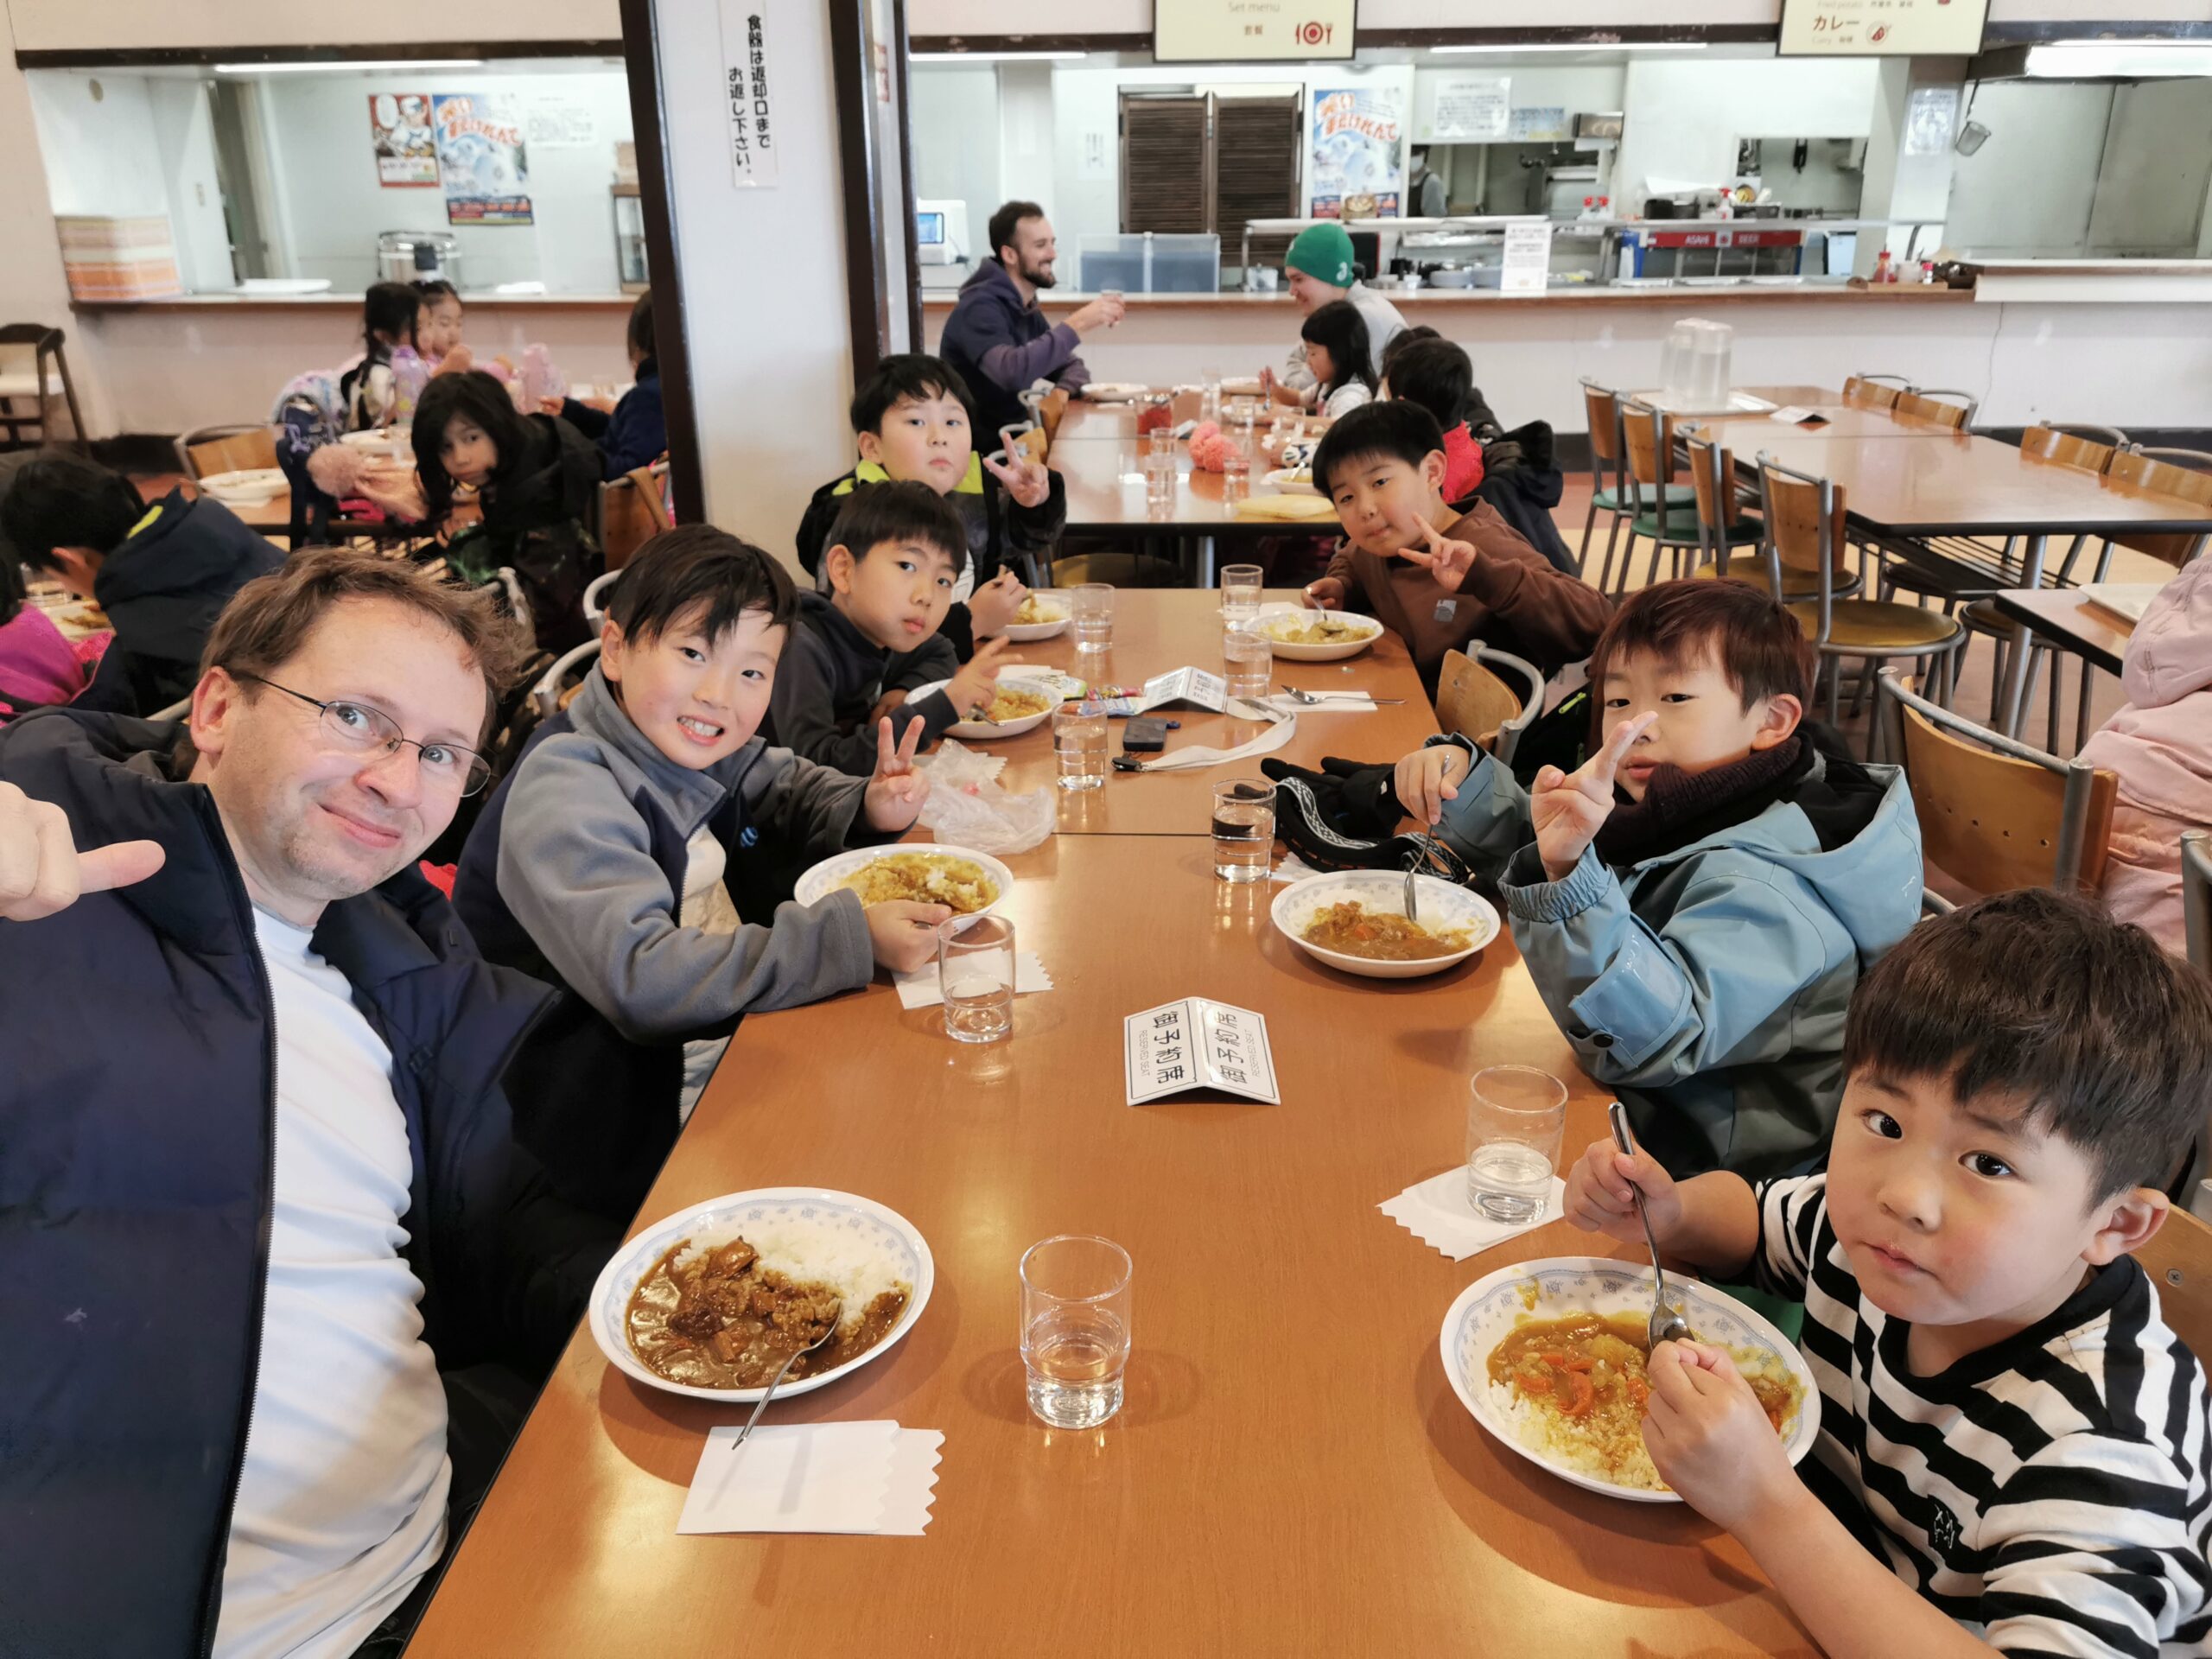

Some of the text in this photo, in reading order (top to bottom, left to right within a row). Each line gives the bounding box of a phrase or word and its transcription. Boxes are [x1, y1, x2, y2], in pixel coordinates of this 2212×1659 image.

[1228, 2, 1281, 13] Set menu
[1813, 15, 1860, 31] カレー
[747, 14, 771, 149] 食器は返却口まで
[1139, 1029, 1151, 1077] RESERVED SEAT
[1153, 1010, 1185, 1084] 御予約席
[1215, 1010, 1249, 1084] 御予約席
